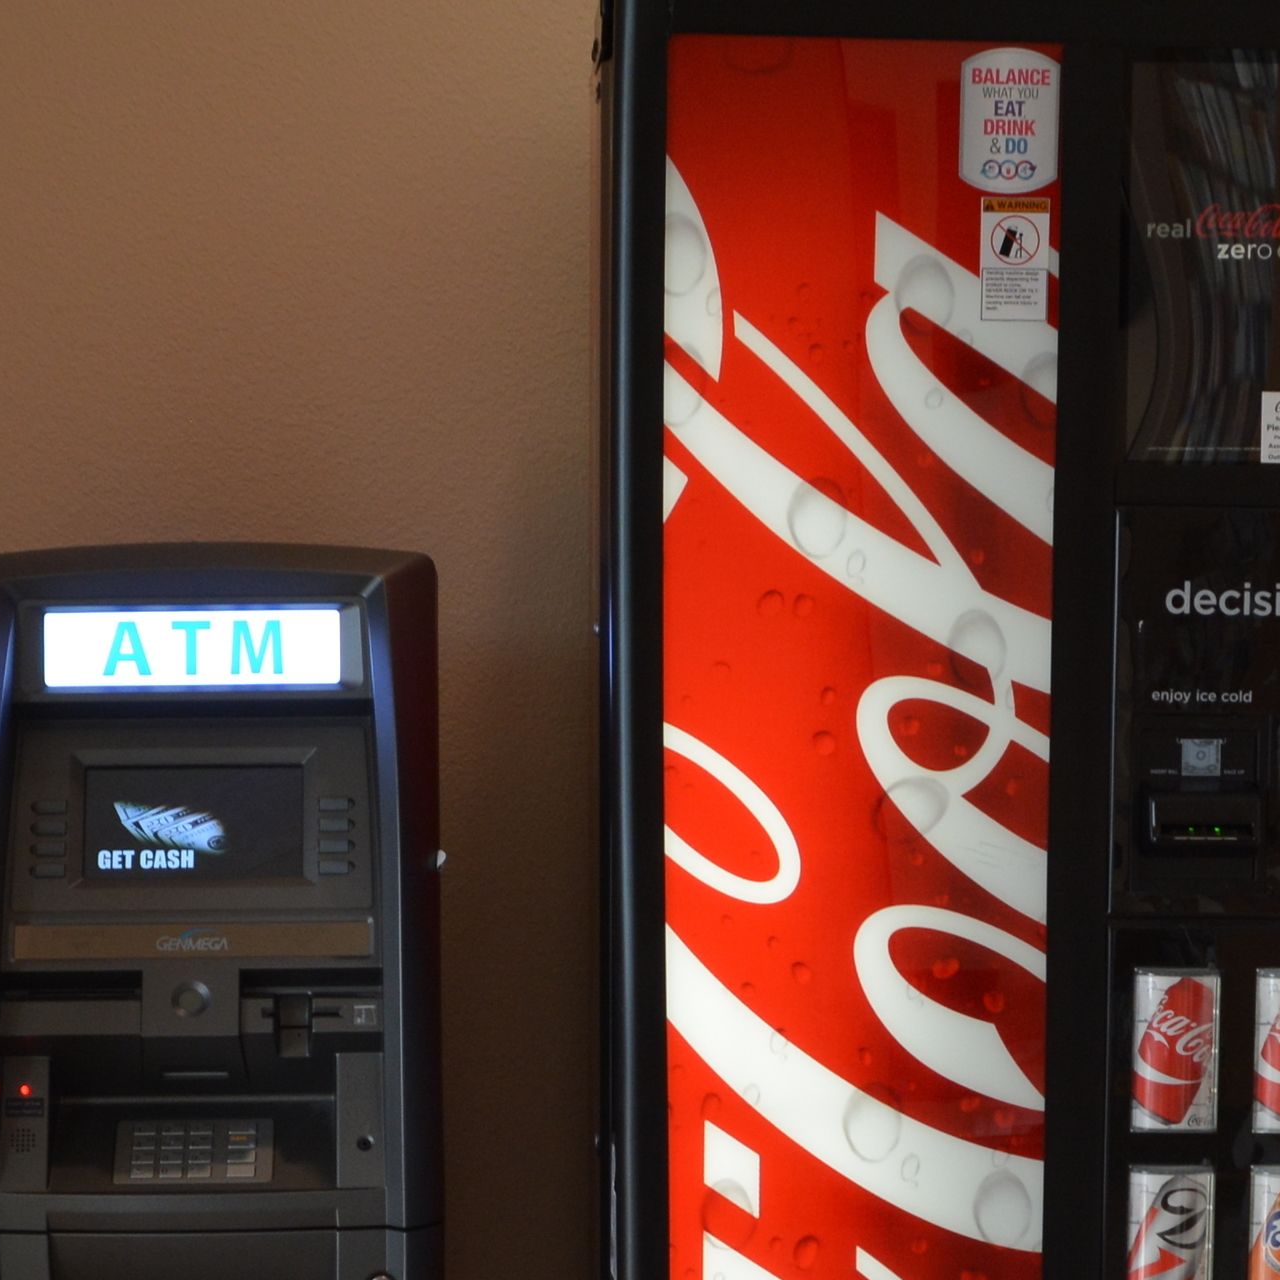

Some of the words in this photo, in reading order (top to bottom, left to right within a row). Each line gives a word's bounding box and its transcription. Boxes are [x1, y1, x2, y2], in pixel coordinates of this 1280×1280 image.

[972, 68, 1051, 86] BALANCE
[982, 87, 1014, 99] WHAT
[1017, 87, 1039, 100] YOU
[983, 119, 1036, 136] DRINK
[990, 137, 1001, 155] &
[1005, 137, 1028, 155] DO
[997, 199, 1048, 210] WARNING
[1146, 218, 1191, 239] real
[1217, 242, 1272, 260] zero
[103, 619, 284, 676] ATM
[1151, 689, 1192, 704] enjoy
[1196, 689, 1217, 702] ice
[1221, 690, 1253, 703] cold
[97, 849, 135, 869] GET
[140, 849, 195, 869] CASH
[155, 935, 229, 952] GENMEGA
